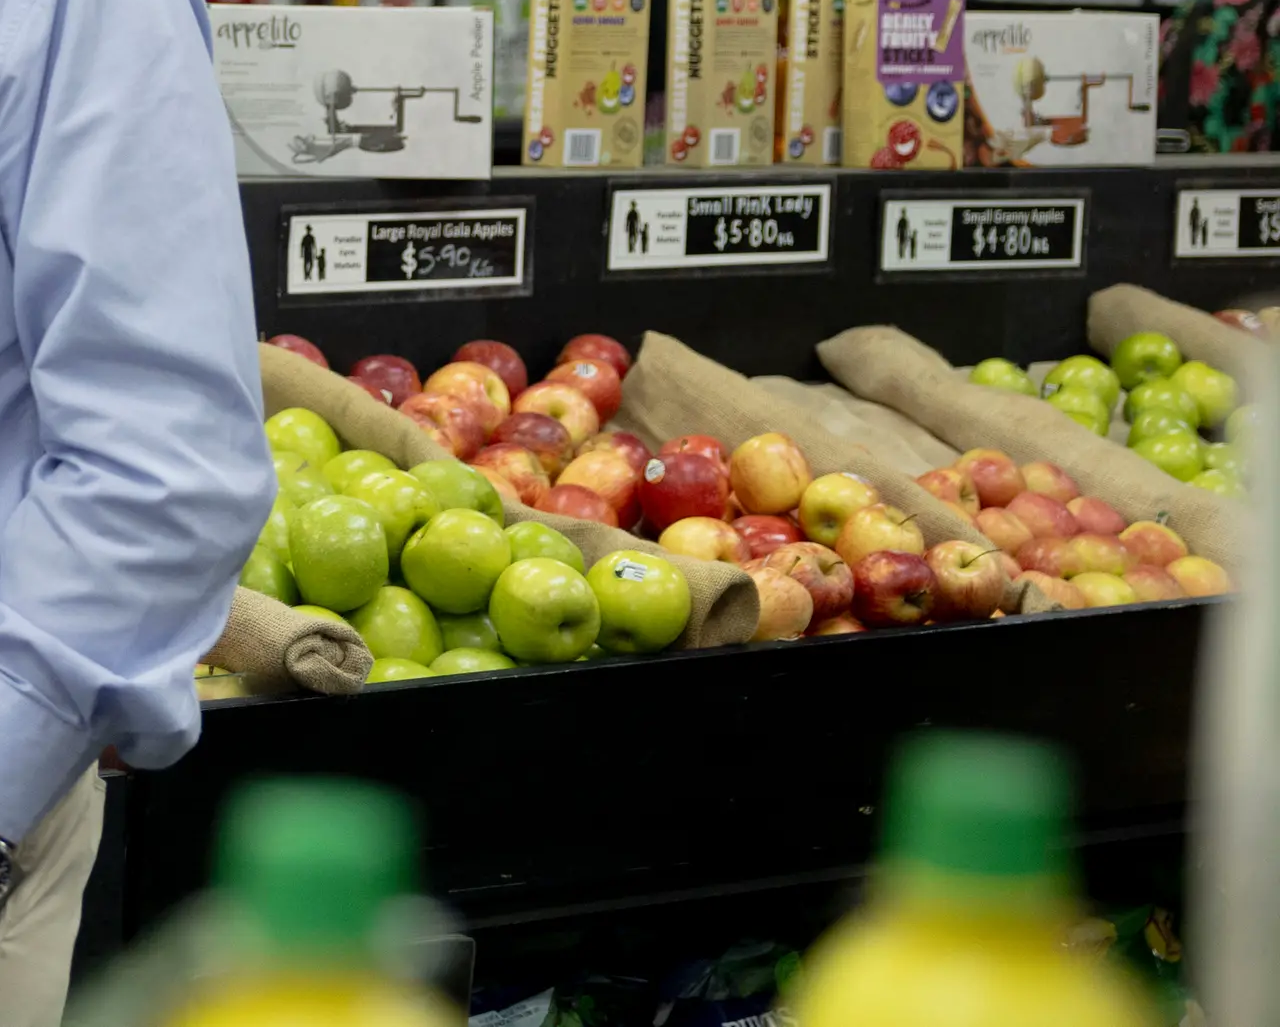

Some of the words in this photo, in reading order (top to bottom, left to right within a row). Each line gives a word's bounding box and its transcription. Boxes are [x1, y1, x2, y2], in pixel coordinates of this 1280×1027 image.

[216, 15, 301, 49] appetito
[689, 195, 733, 216] Small
[775, 194, 814, 219] Lady
[962, 208, 993, 225] Small
[994, 209, 1030, 225] Granny
[372, 225, 405, 243] Large
[407, 223, 442, 242] Royal
[444, 222, 471, 239] Gala
[472, 221, 514, 239] Apples
